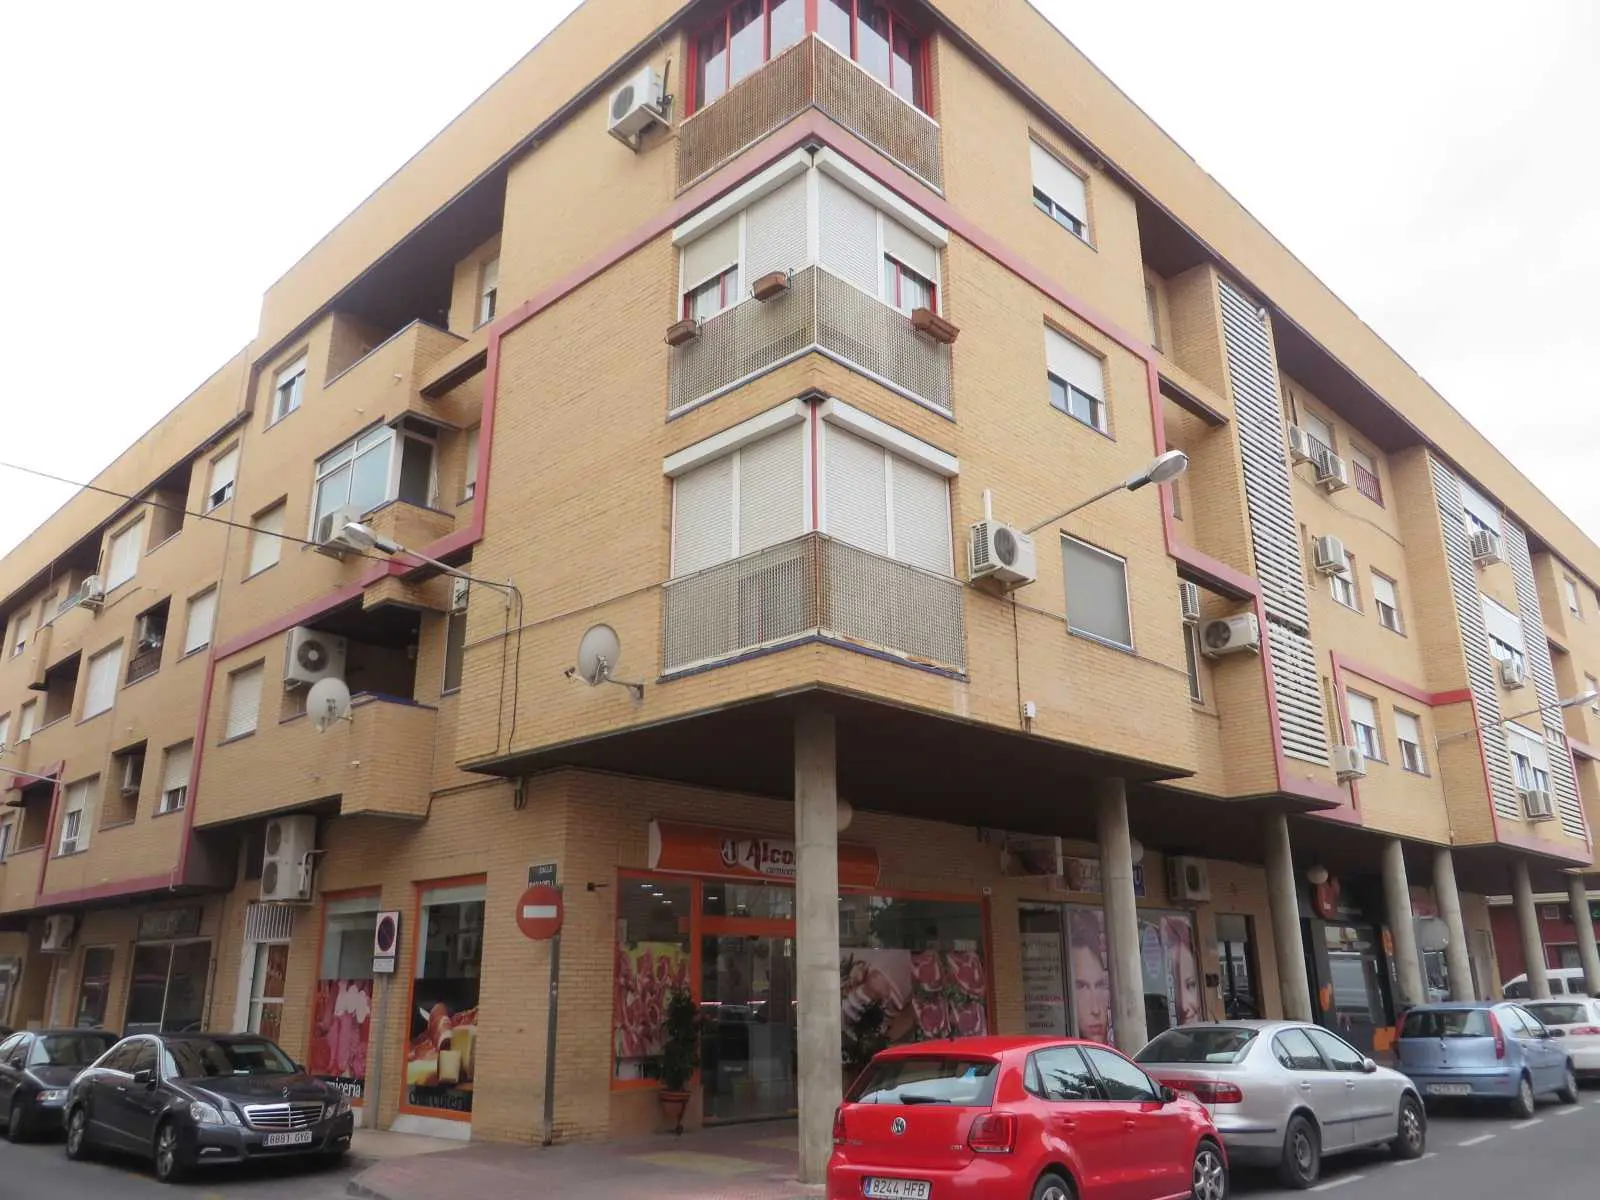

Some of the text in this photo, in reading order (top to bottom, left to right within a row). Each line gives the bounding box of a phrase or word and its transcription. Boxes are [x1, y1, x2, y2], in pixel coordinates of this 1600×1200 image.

[746, 837, 797, 871] Alco
[873, 1181, 926, 1196] 8244 HFB
